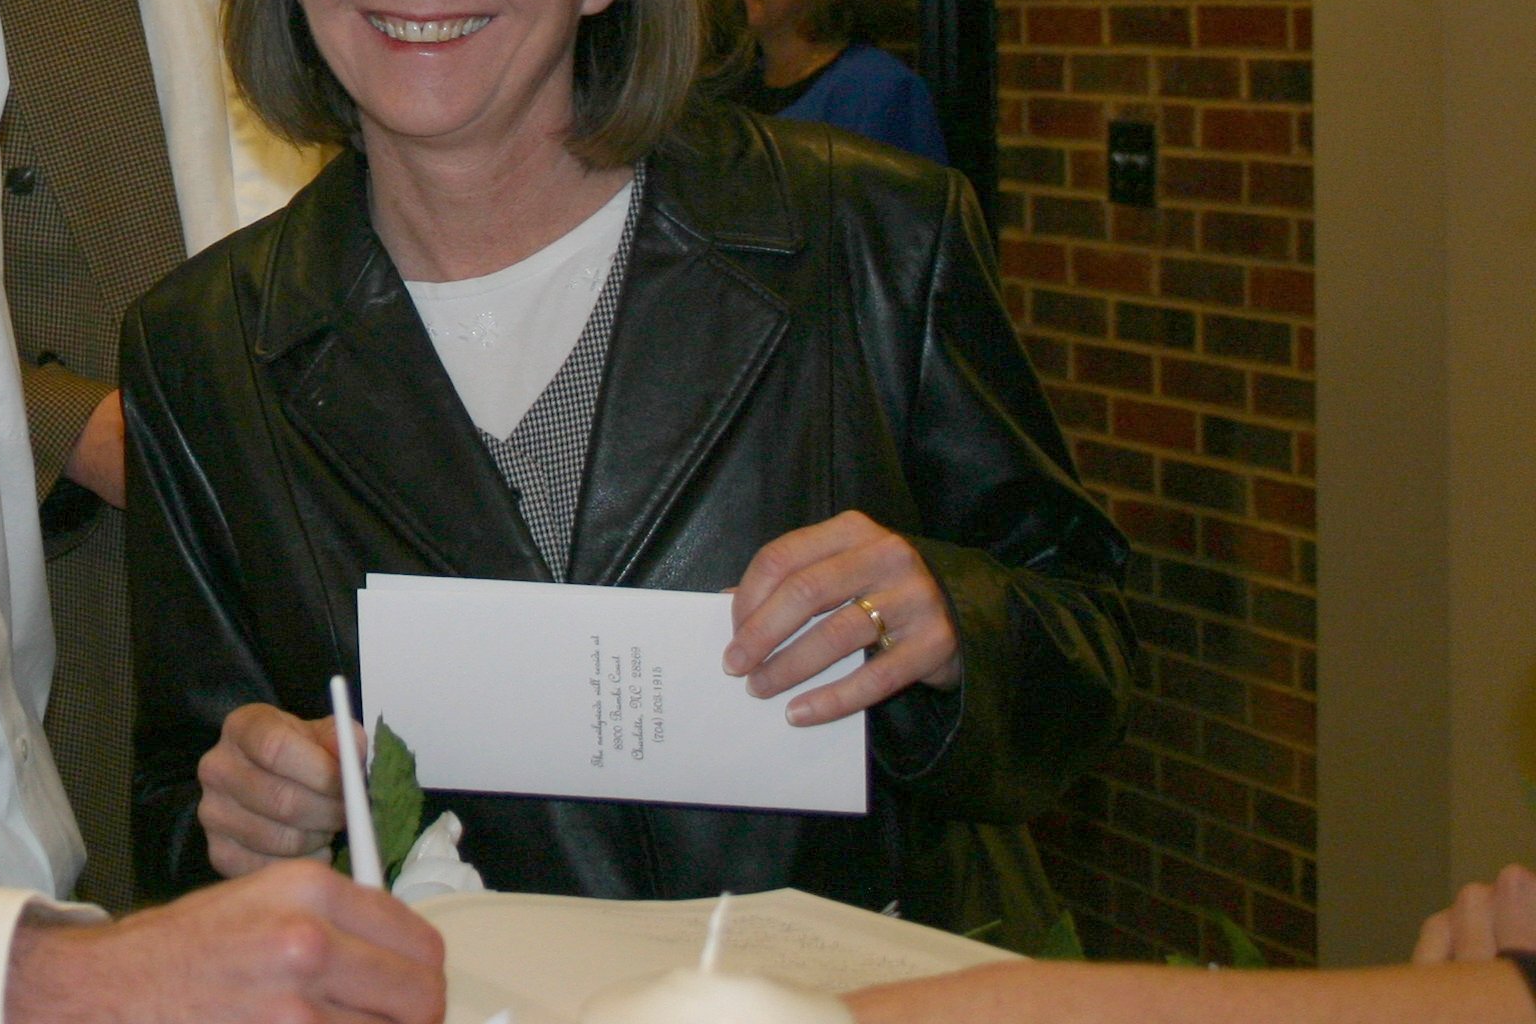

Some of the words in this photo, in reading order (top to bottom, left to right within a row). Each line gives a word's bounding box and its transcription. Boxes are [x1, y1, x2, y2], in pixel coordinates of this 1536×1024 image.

[590, 650, 600, 675] reside
[608, 656, 621, 683] Court
[631, 647, 641, 678] 28269
[589, 678, 600, 695] will
[629, 685, 642, 709] NC
[590, 700, 607, 745] newlyweds
[651, 718, 664, 743] (704)
[590, 750, 603, 767] The
